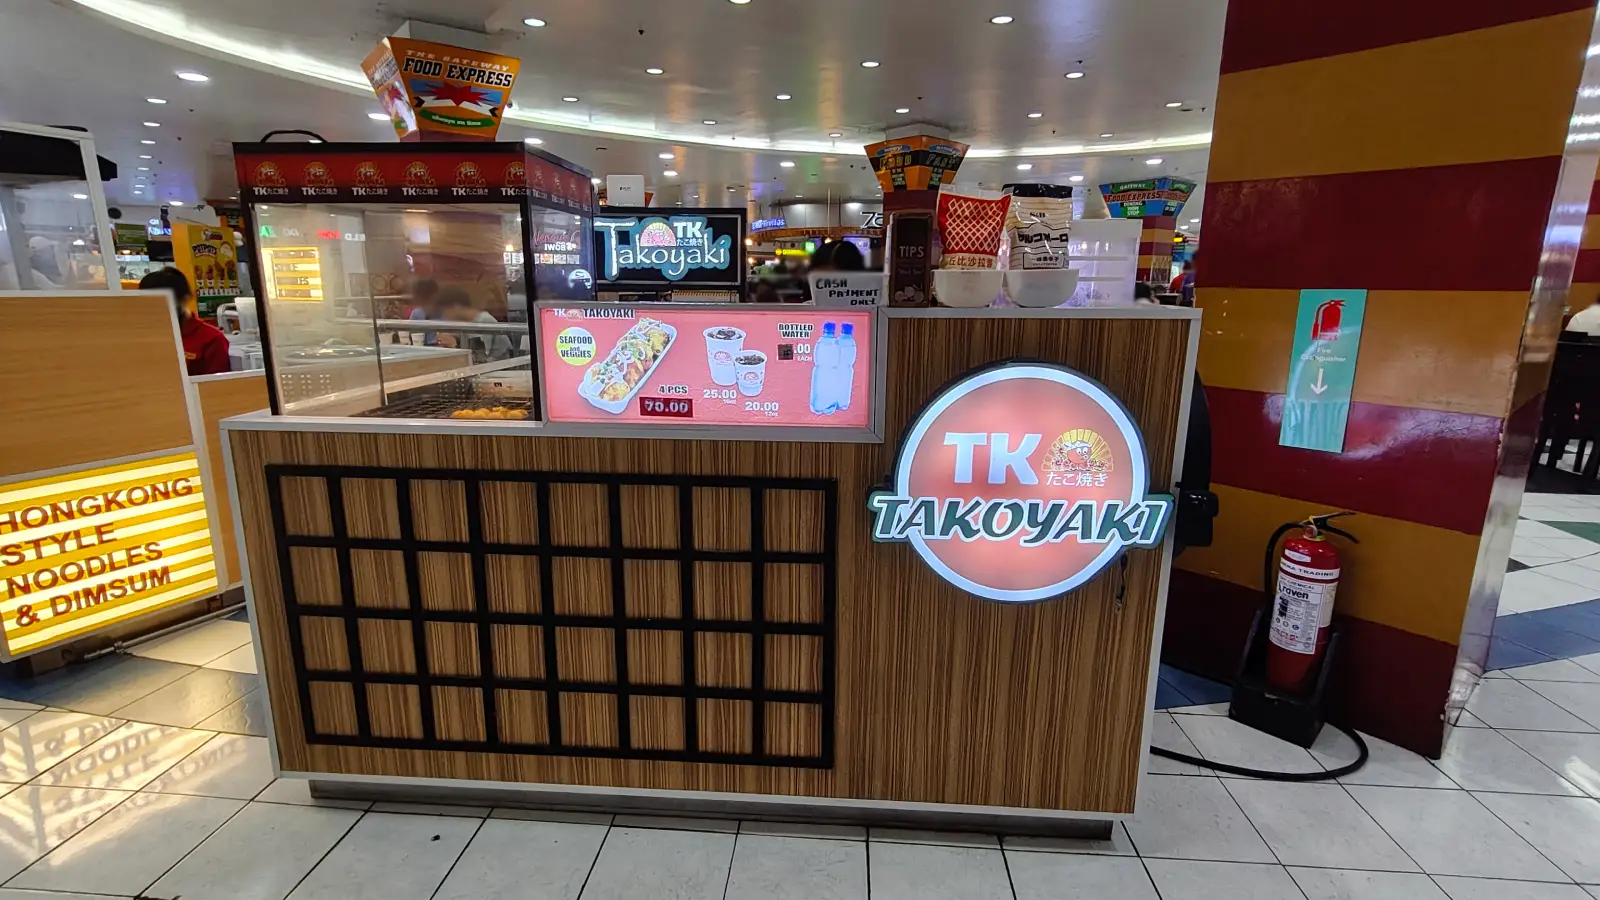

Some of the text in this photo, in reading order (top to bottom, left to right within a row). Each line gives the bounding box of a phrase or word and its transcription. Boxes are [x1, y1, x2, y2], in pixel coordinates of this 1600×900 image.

[405, 49, 510, 72] THE GATEWAY
[402, 56, 443, 77] FOOD
[446, 64, 513, 88] EXPRESS
[253, 187, 267, 196] TK
[301, 187, 315, 196] TK
[352, 187, 366, 196] TK
[402, 187, 416, 196] TK
[452, 187, 466, 196] TK
[501, 187, 515, 196] TK
[1127, 191, 1163, 200] EXPRESS
[674, 221, 702, 238] TK
[594, 222, 727, 276] Takoyaki
[899, 245, 924, 258] TIPS
[816, 278, 848, 290] CASH
[828, 289, 879, 298] PAYMENT
[553, 308, 635, 319] TK TAKOYAKI
[778, 323, 813, 331] BOTTLED
[782, 330, 810, 338] WATER
[559, 335, 593, 344] SEAFOOD
[560, 350, 592, 358] VEGGIES
[659, 385, 688, 394] 4 PCS
[703, 389, 737, 399] 25.00
[645, 400, 689, 413] 70.00
[744, 401, 779, 411] 20.00
[943, 432, 1041, 485] TK
[1046, 471, 1108, 487] たこ焼き
[0, 478, 193, 535] HONGKONG
[873, 496, 1167, 547] TAKOYAKI
[0, 522, 117, 566] STYLE
[6, 542, 163, 599] NOODLES
[1299, 568, 1334, 577] TRADING
[16, 565, 172, 627] & DIMSUM
